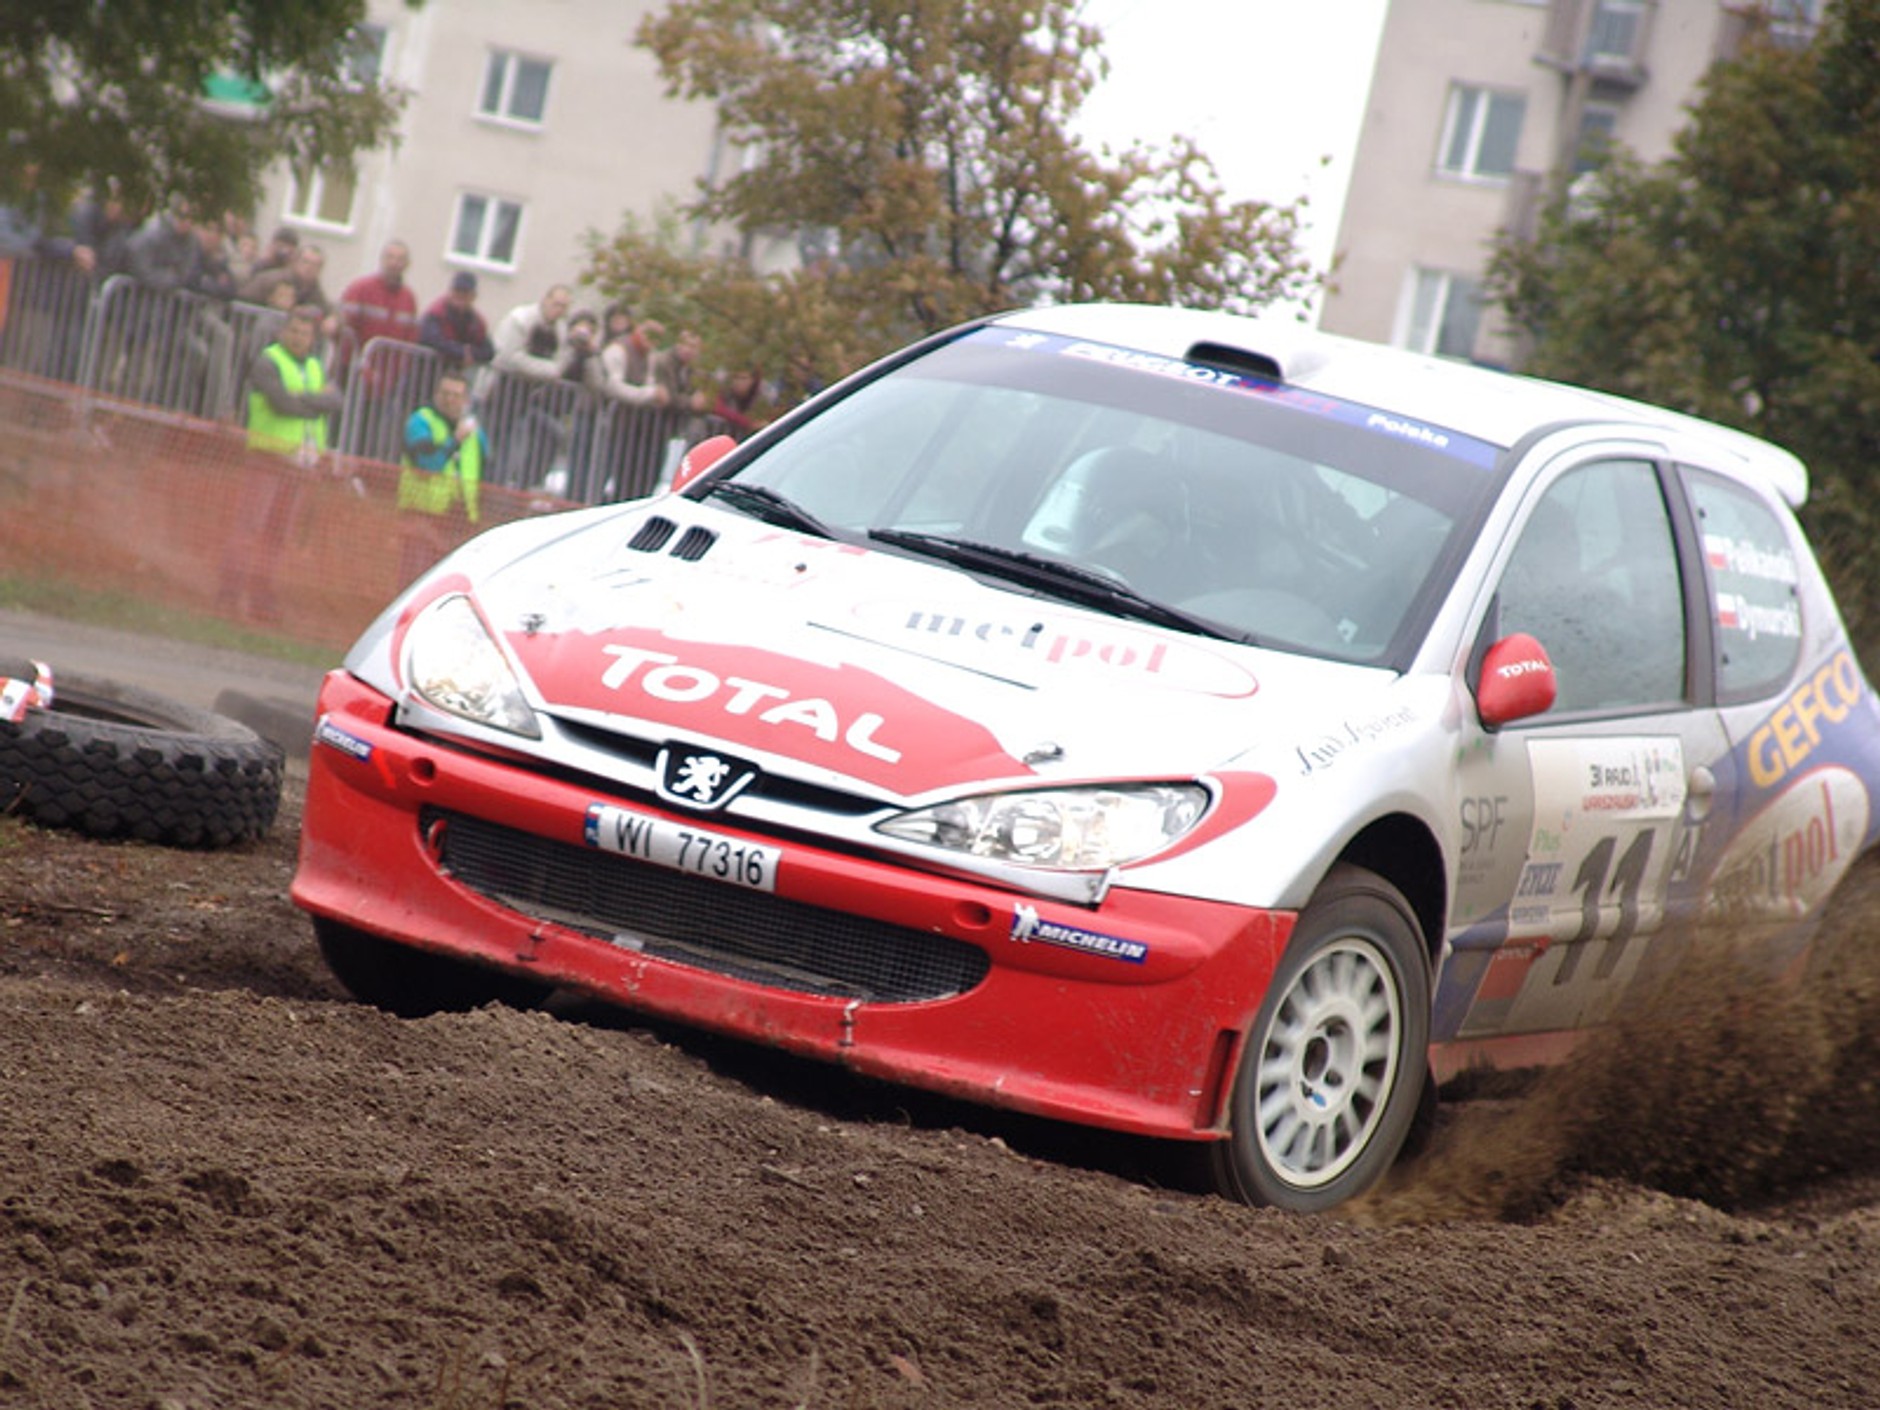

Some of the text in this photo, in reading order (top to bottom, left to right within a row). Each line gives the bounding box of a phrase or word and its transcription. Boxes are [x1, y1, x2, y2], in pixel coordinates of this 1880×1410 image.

[1367, 413, 1449, 448] Polska
[1497, 659, 1549, 679] TOTAL
[600, 644, 904, 765] TOTAL
[1747, 650, 1861, 788] GEFCO
[615, 813, 766, 886] WI 77316
[1460, 796, 1508, 854] SPF
[1553, 828, 1656, 986] 11
[1037, 924, 1146, 959] MICHELIN
